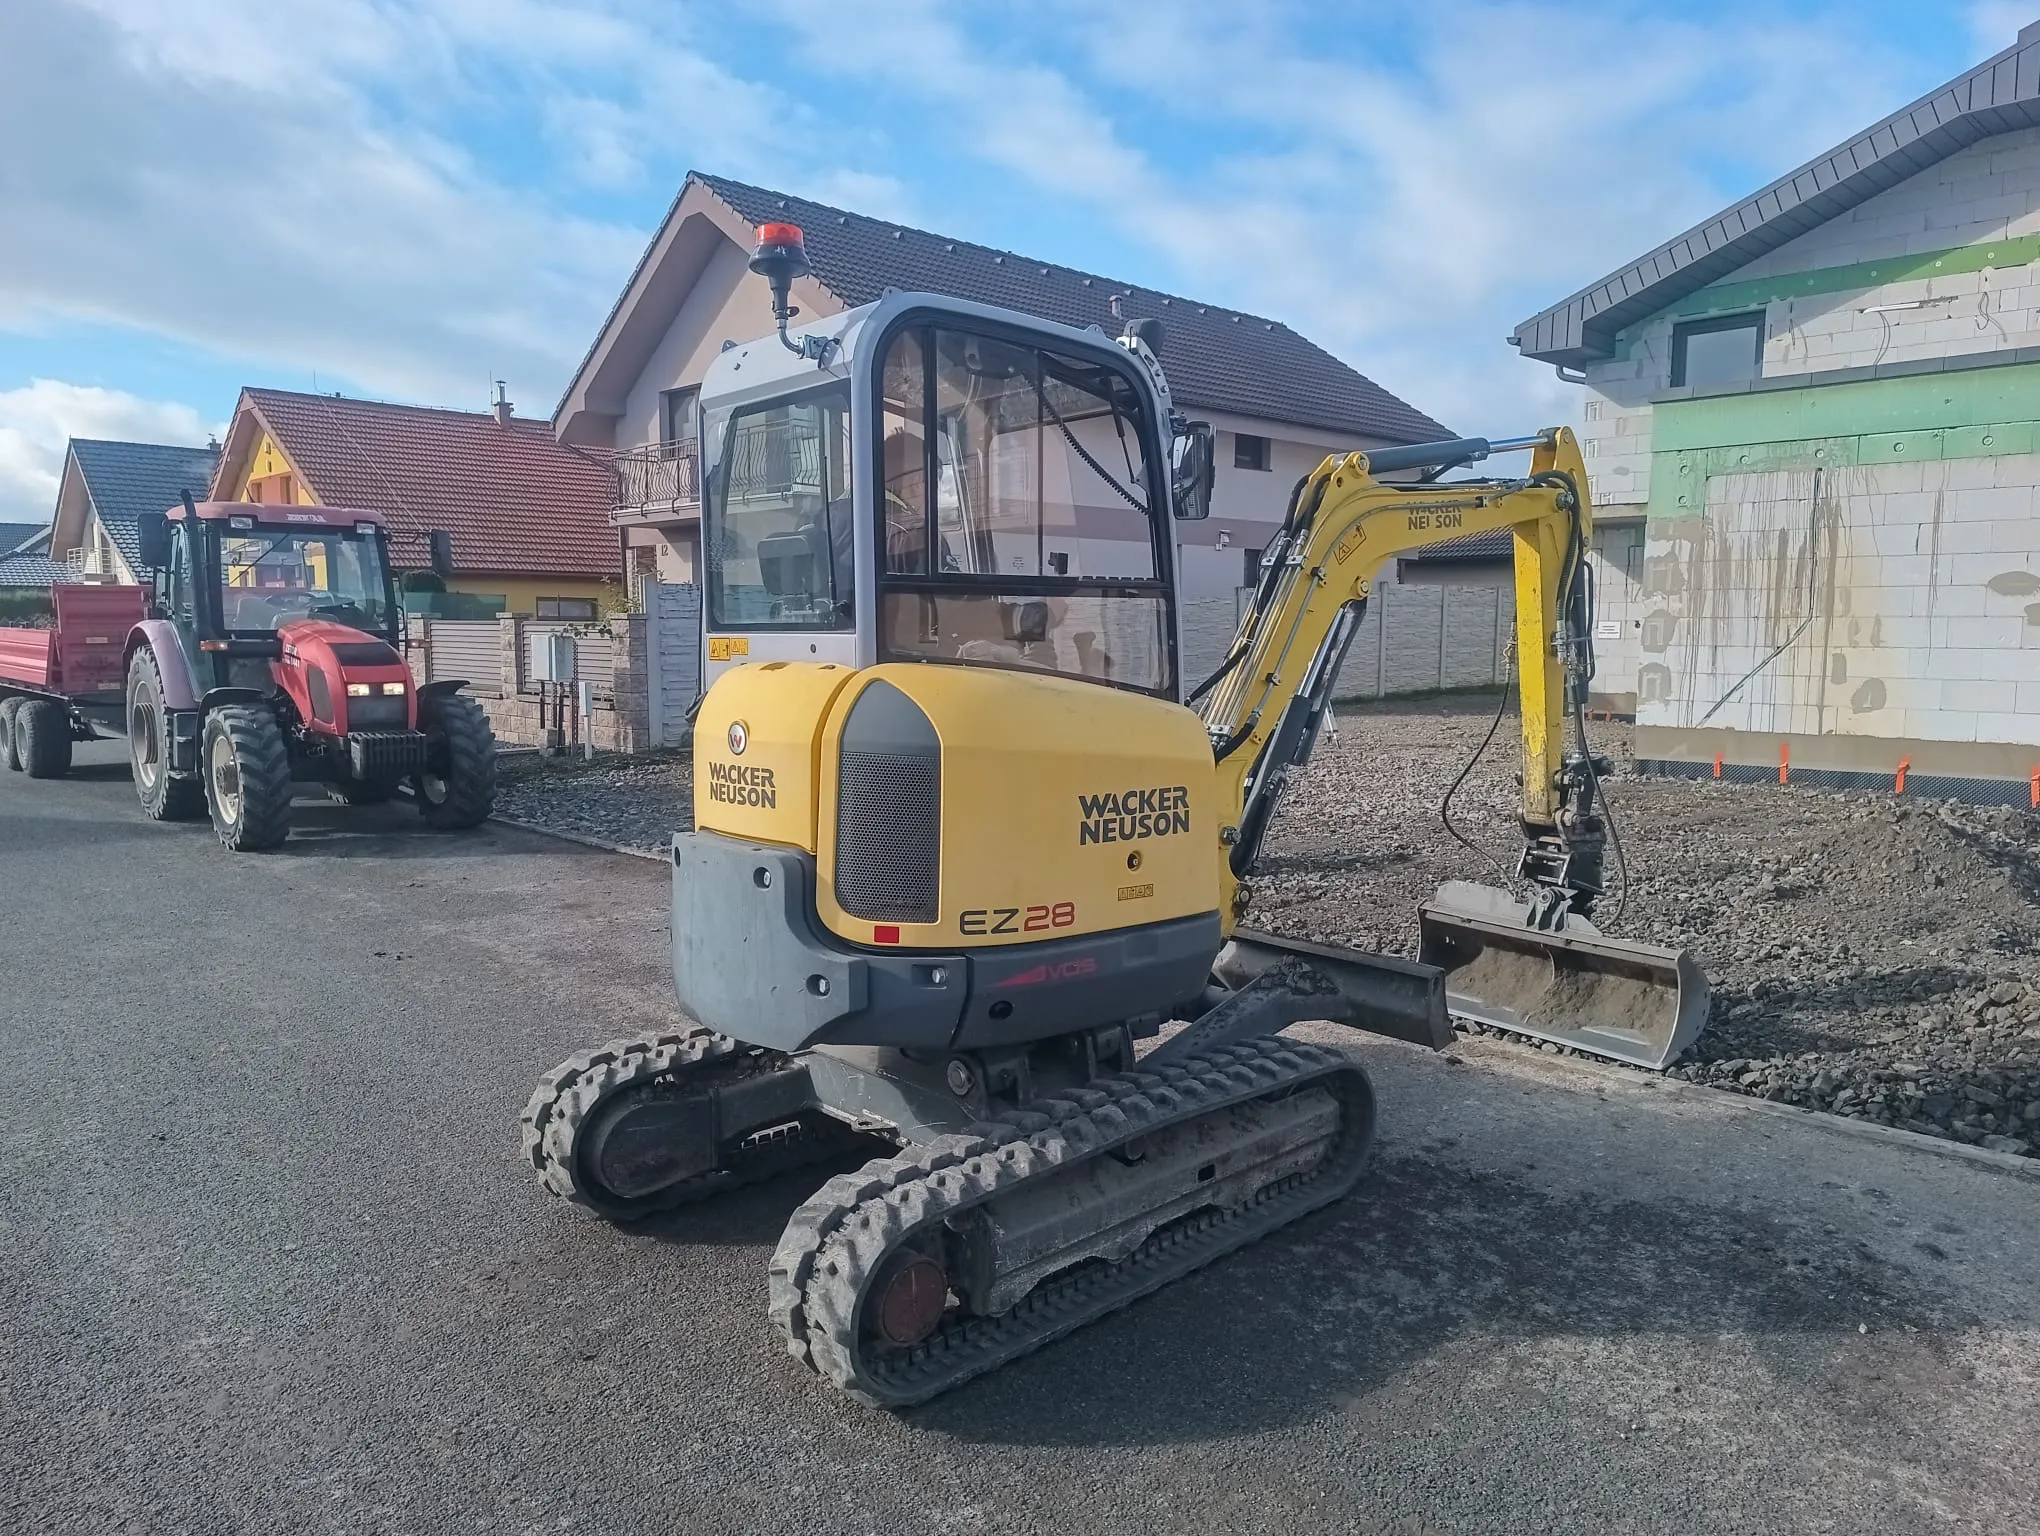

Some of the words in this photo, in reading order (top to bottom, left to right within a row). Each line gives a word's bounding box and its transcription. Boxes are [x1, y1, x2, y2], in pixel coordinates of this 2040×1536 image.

[661, 544, 669, 557] 12
[708, 761, 776, 789] WACKER
[709, 781, 776, 809] NEUSON
[1078, 786, 1190, 820] WACKER
[1080, 810, 1190, 846] NEUSON
[959, 901, 1076, 936] EZ28
